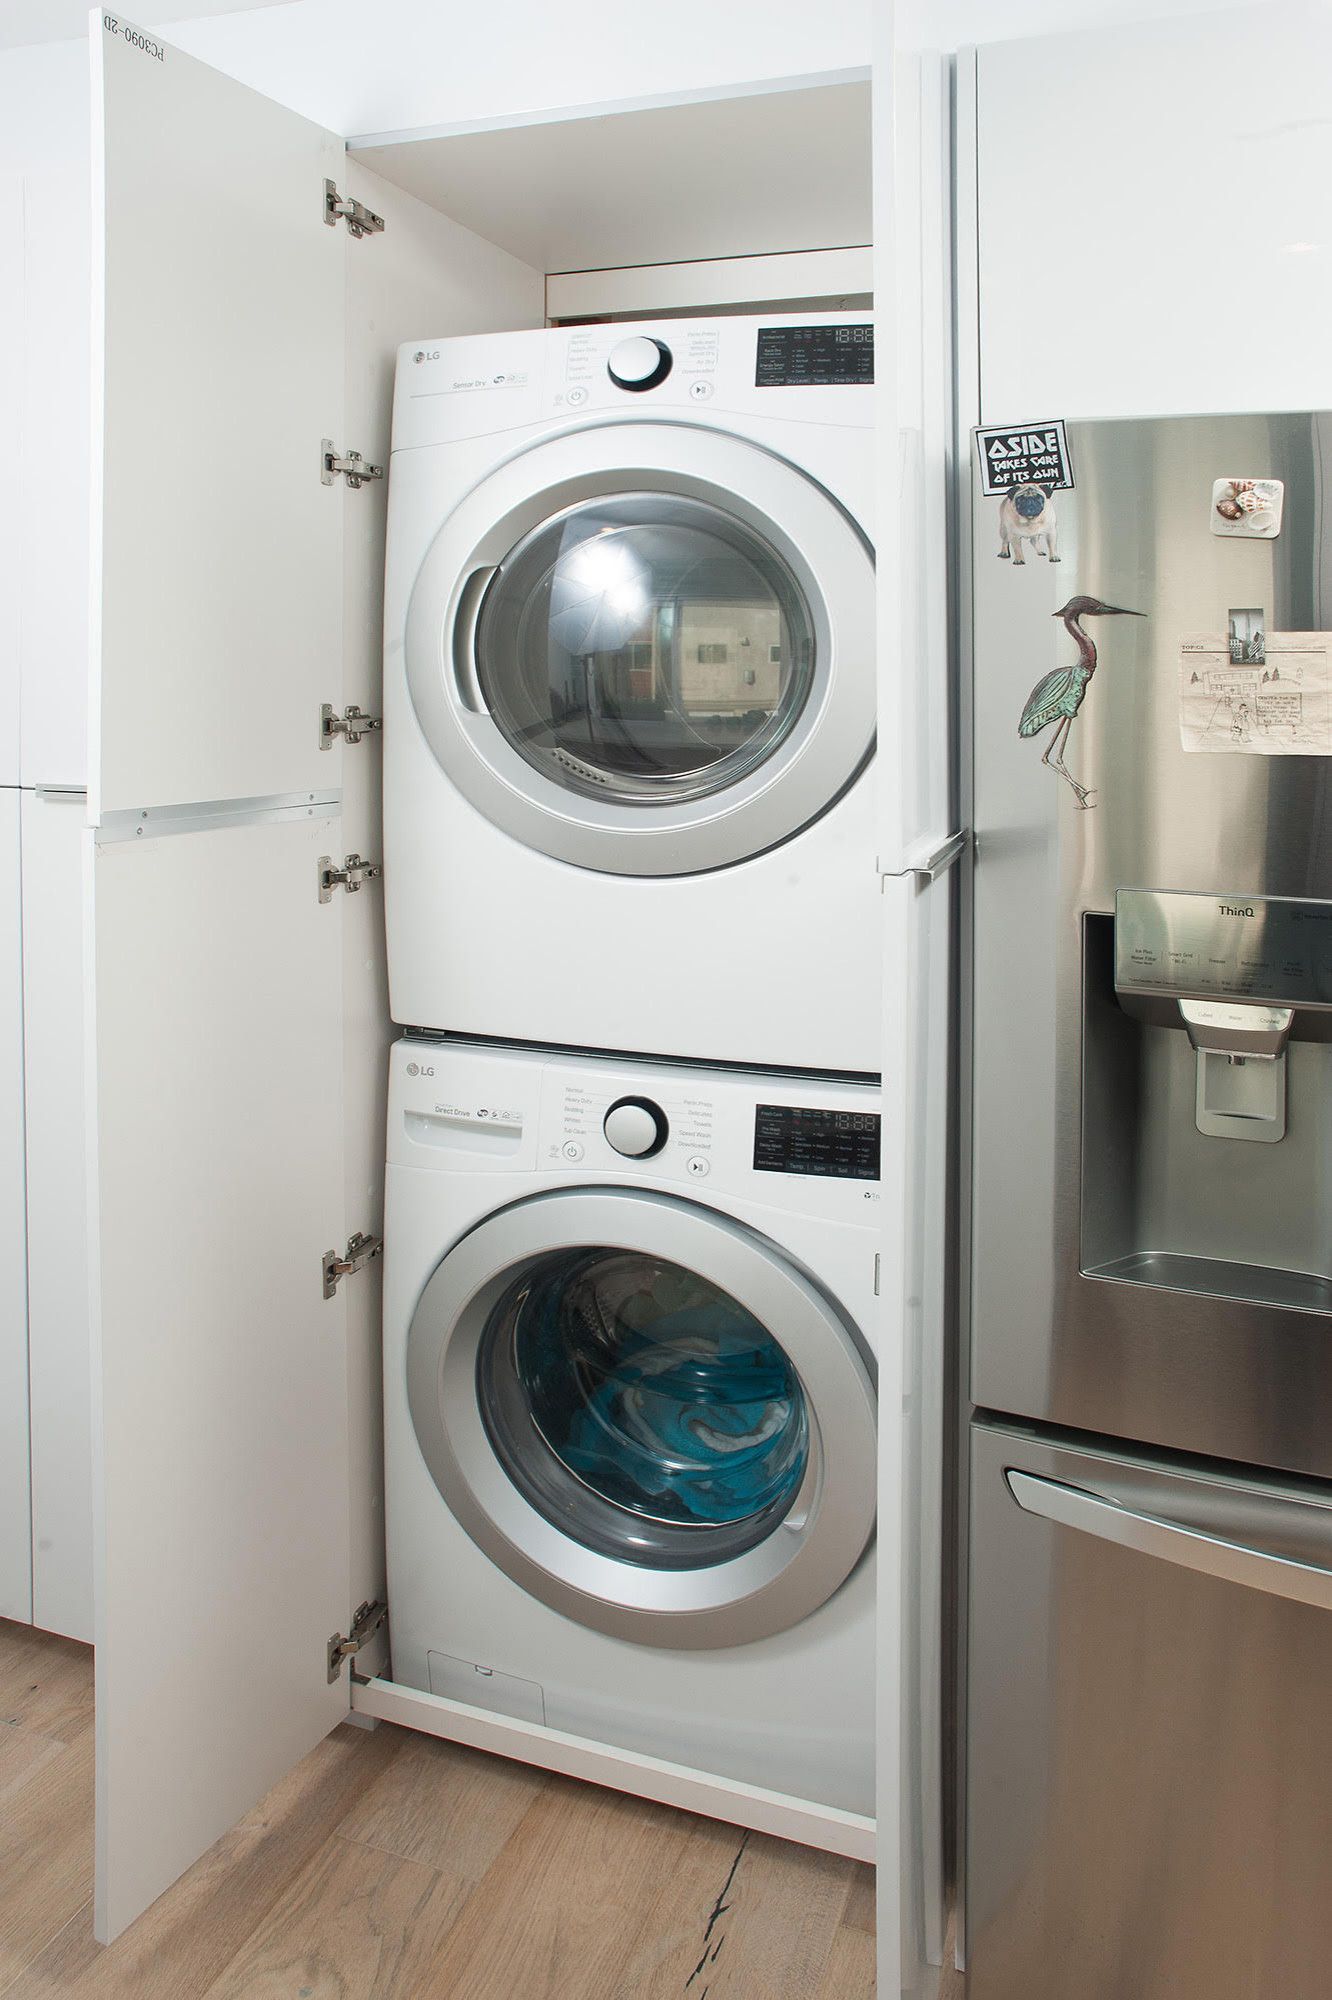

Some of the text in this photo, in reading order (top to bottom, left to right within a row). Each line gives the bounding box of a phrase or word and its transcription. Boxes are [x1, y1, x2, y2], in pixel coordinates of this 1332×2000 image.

[104, 15, 164, 62] PC3090-2D
[426, 351, 440, 362] LG
[452, 380, 486, 390] Sensor Dry
[992, 454, 1059, 472] TAKES CARE
[994, 468, 1059, 484] OF ITS OWN
[1218, 905, 1255, 918] ThinQ
[421, 1066, 435, 1077] LG
[435, 1106, 470, 1118] Direct Drive
